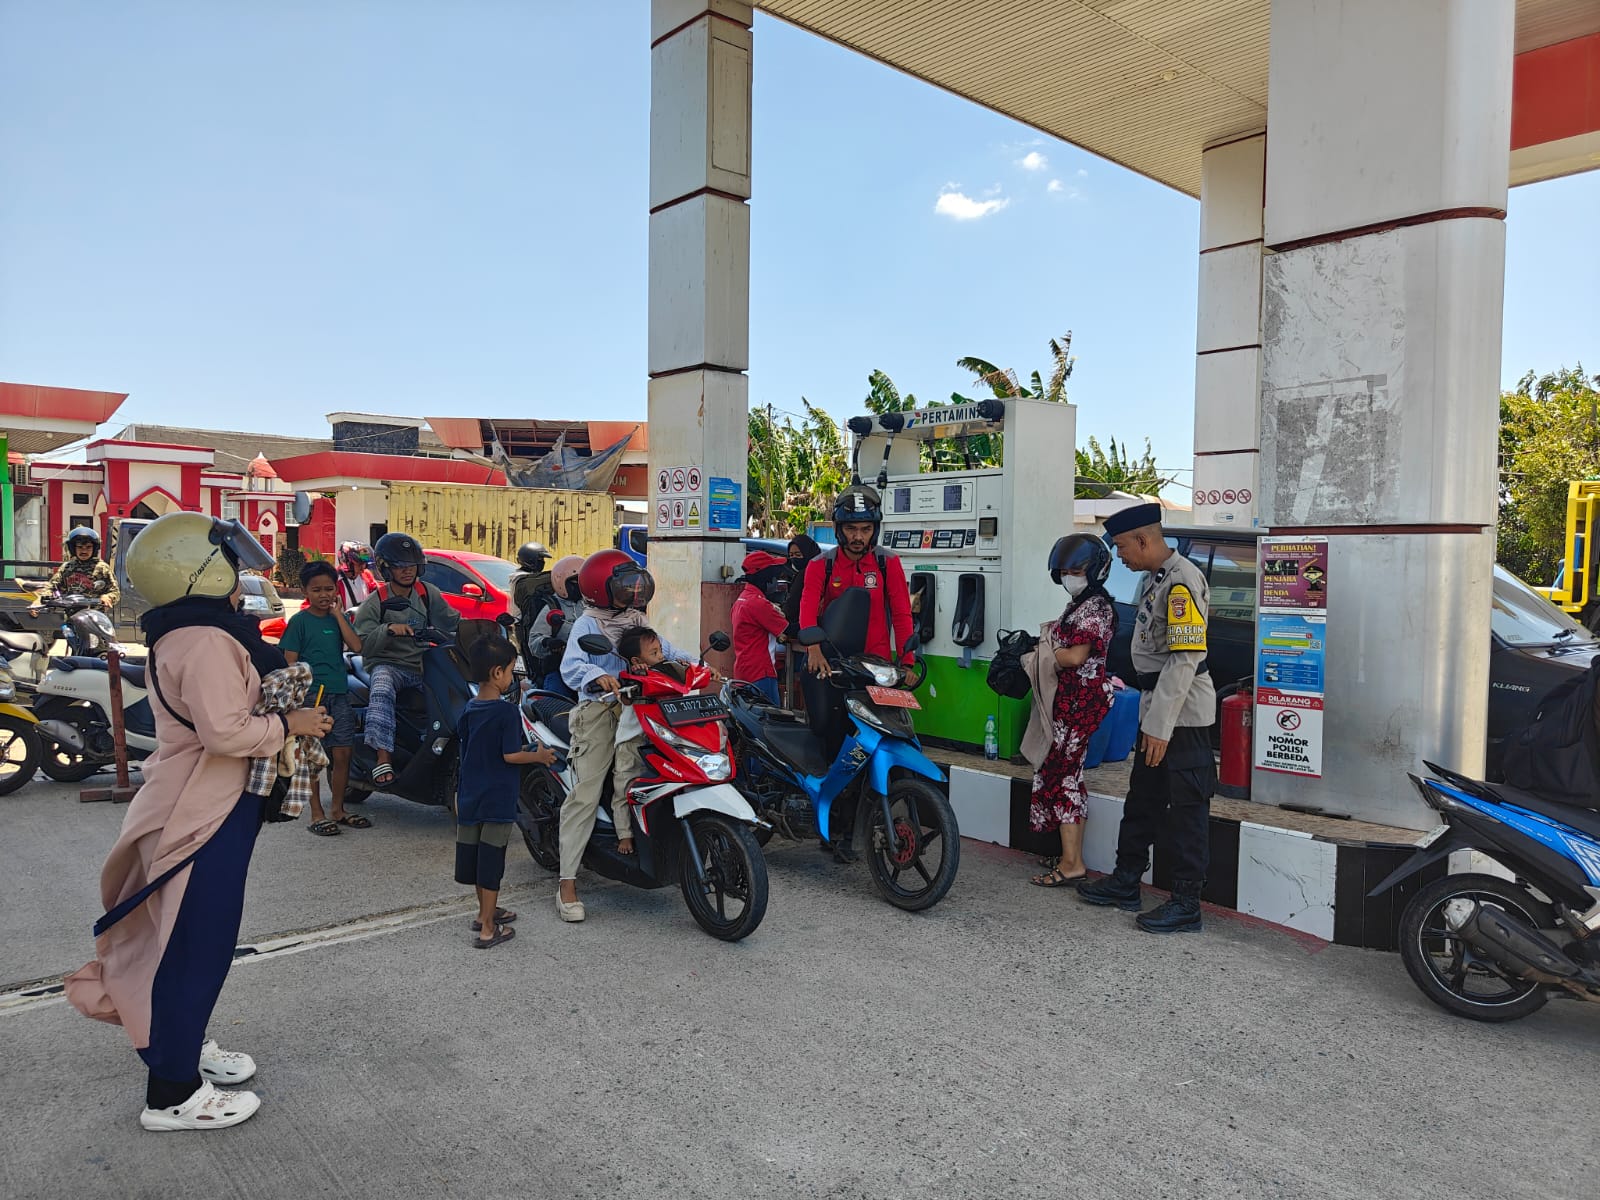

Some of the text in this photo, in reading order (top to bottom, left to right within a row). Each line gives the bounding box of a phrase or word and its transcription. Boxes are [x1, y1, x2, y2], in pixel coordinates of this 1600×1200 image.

[1271, 544, 1317, 552] PERHATIAN!
[188, 555, 213, 585] Classic
[1264, 589, 1289, 597] DENDA
[1268, 695, 1311, 705] DILARANG
[1268, 735, 1309, 747] NOMOR
[1273, 744, 1303, 754] POLISI
[1266, 751, 1310, 763] BERBEDA
